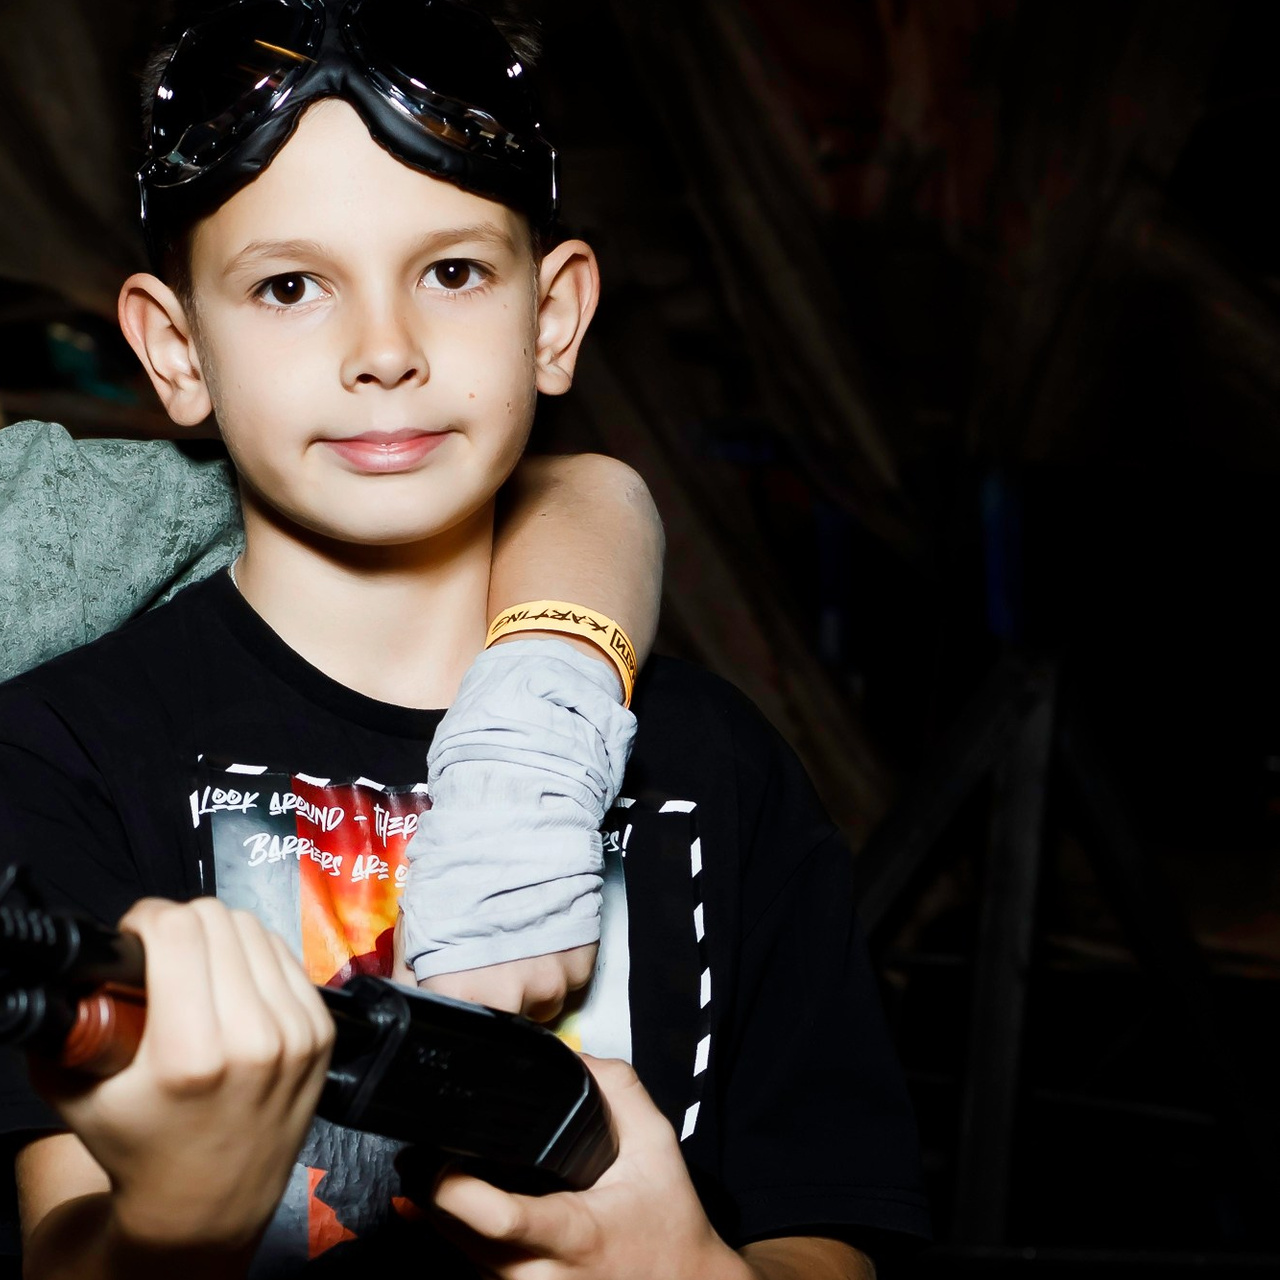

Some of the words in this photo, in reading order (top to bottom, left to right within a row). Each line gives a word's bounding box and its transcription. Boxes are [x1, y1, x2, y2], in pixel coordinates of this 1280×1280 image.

[198, 785, 260, 815] LOOK
[269, 791, 345, 833] AROUND
[373, 803, 418, 848] THER
[242, 832, 343, 877] BARRIERS
[350, 854, 390, 883] ARE
